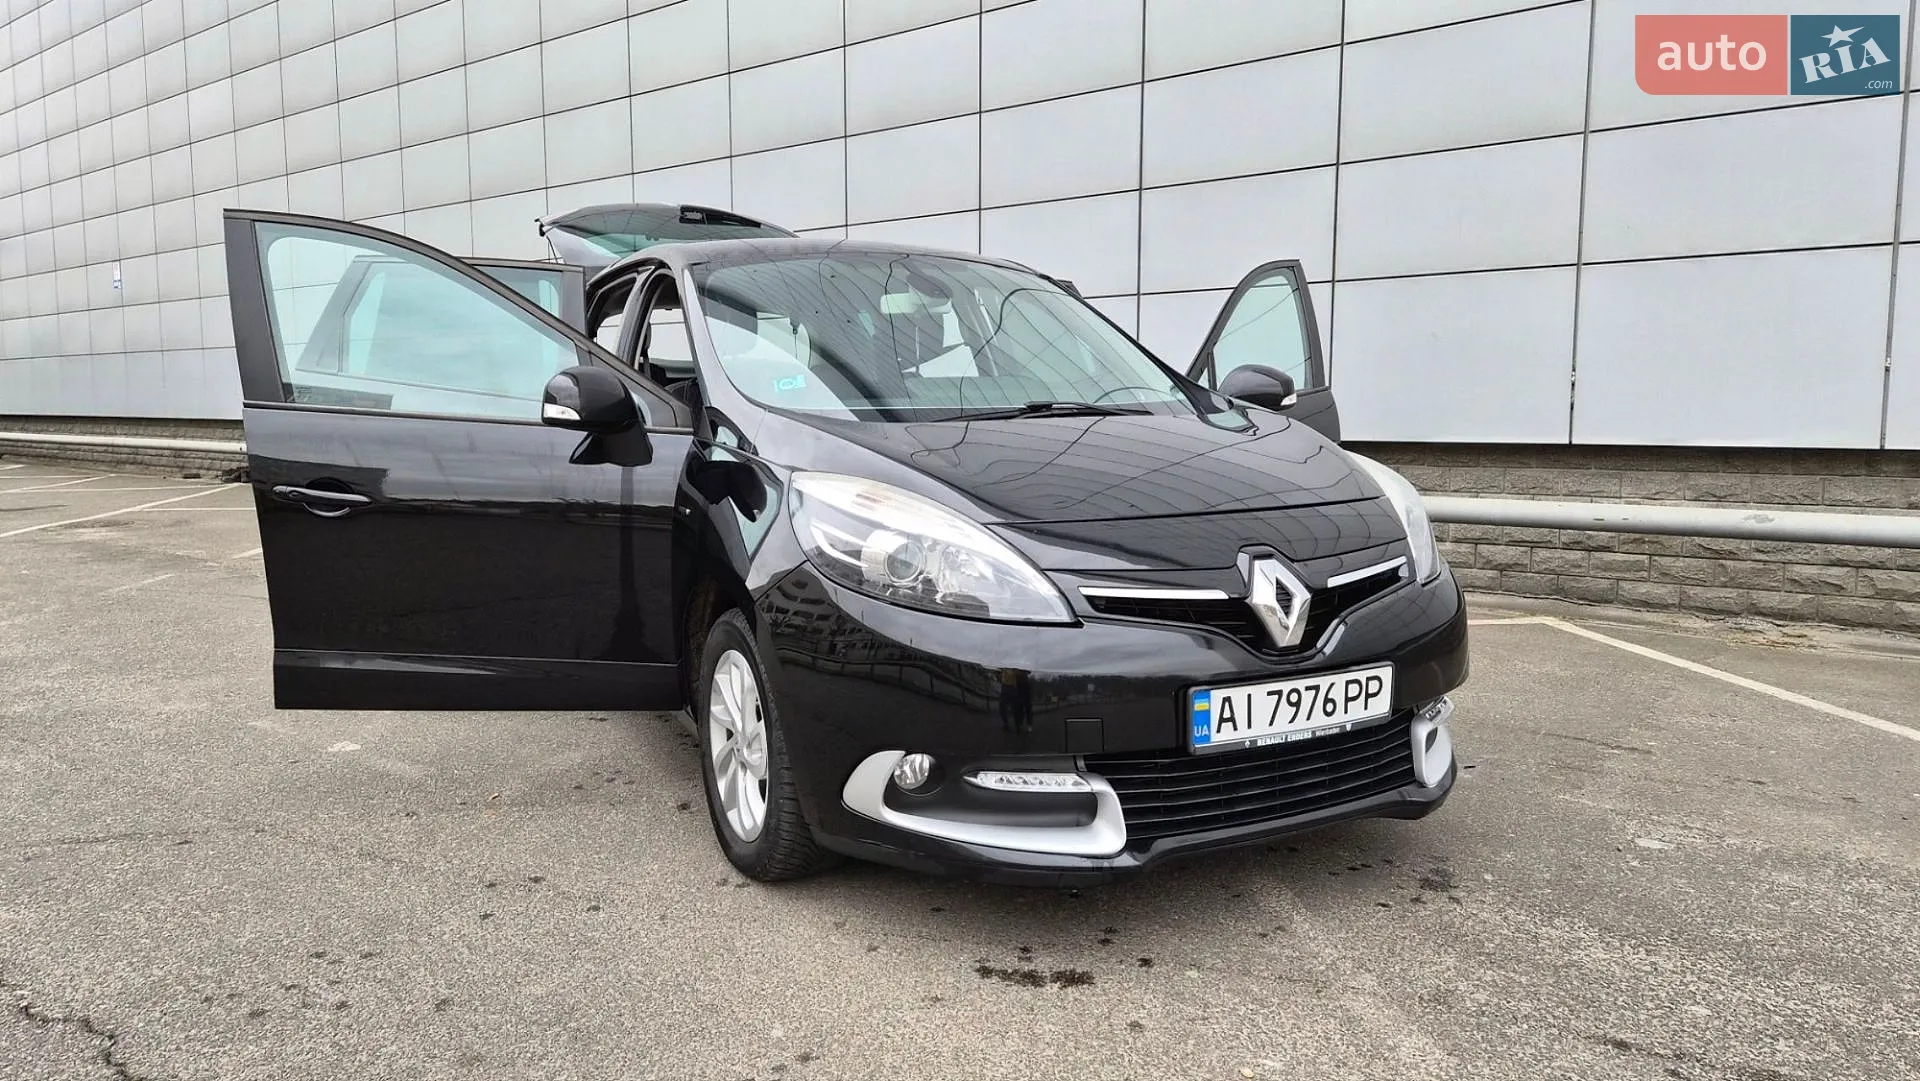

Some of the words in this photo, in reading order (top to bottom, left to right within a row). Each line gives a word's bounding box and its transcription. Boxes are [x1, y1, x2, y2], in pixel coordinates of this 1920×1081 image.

[1216, 693, 1252, 734] AI
[1266, 682, 1337, 727] 7976
[1344, 675, 1383, 715] PP
[1194, 725, 1209, 736] UA
[1257, 734, 1285, 746] RENAULT
